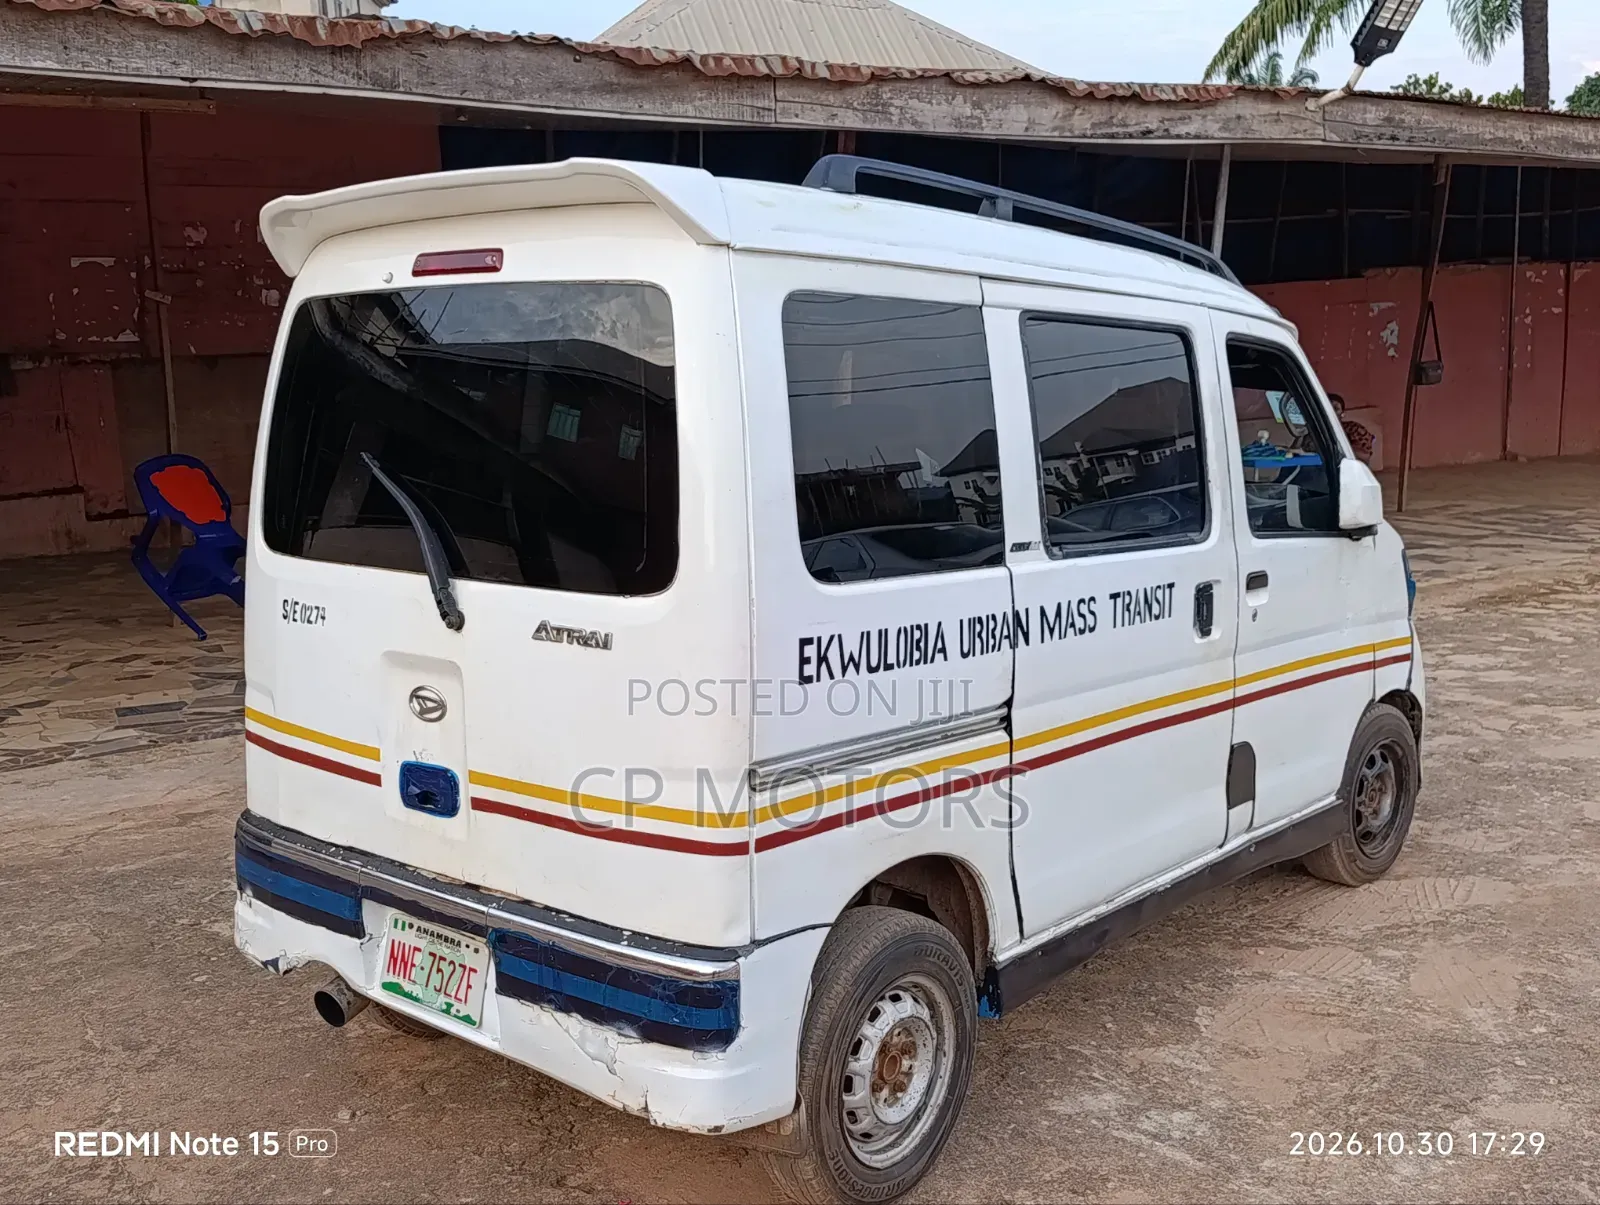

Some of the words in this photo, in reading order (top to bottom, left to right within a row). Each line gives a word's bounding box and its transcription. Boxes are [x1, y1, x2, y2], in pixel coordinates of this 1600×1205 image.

[531, 619, 614, 651] ATRAI
[798, 621, 949, 686] EKWULOBIA
[959, 606, 1031, 660] URBAN
[1039, 595, 1098, 645] MASS
[1108, 581, 1176, 629] TRANSIT
[415, 924, 462, 949] ANAMBRA
[826, 1147, 907, 1200] BRIDGESTONE
